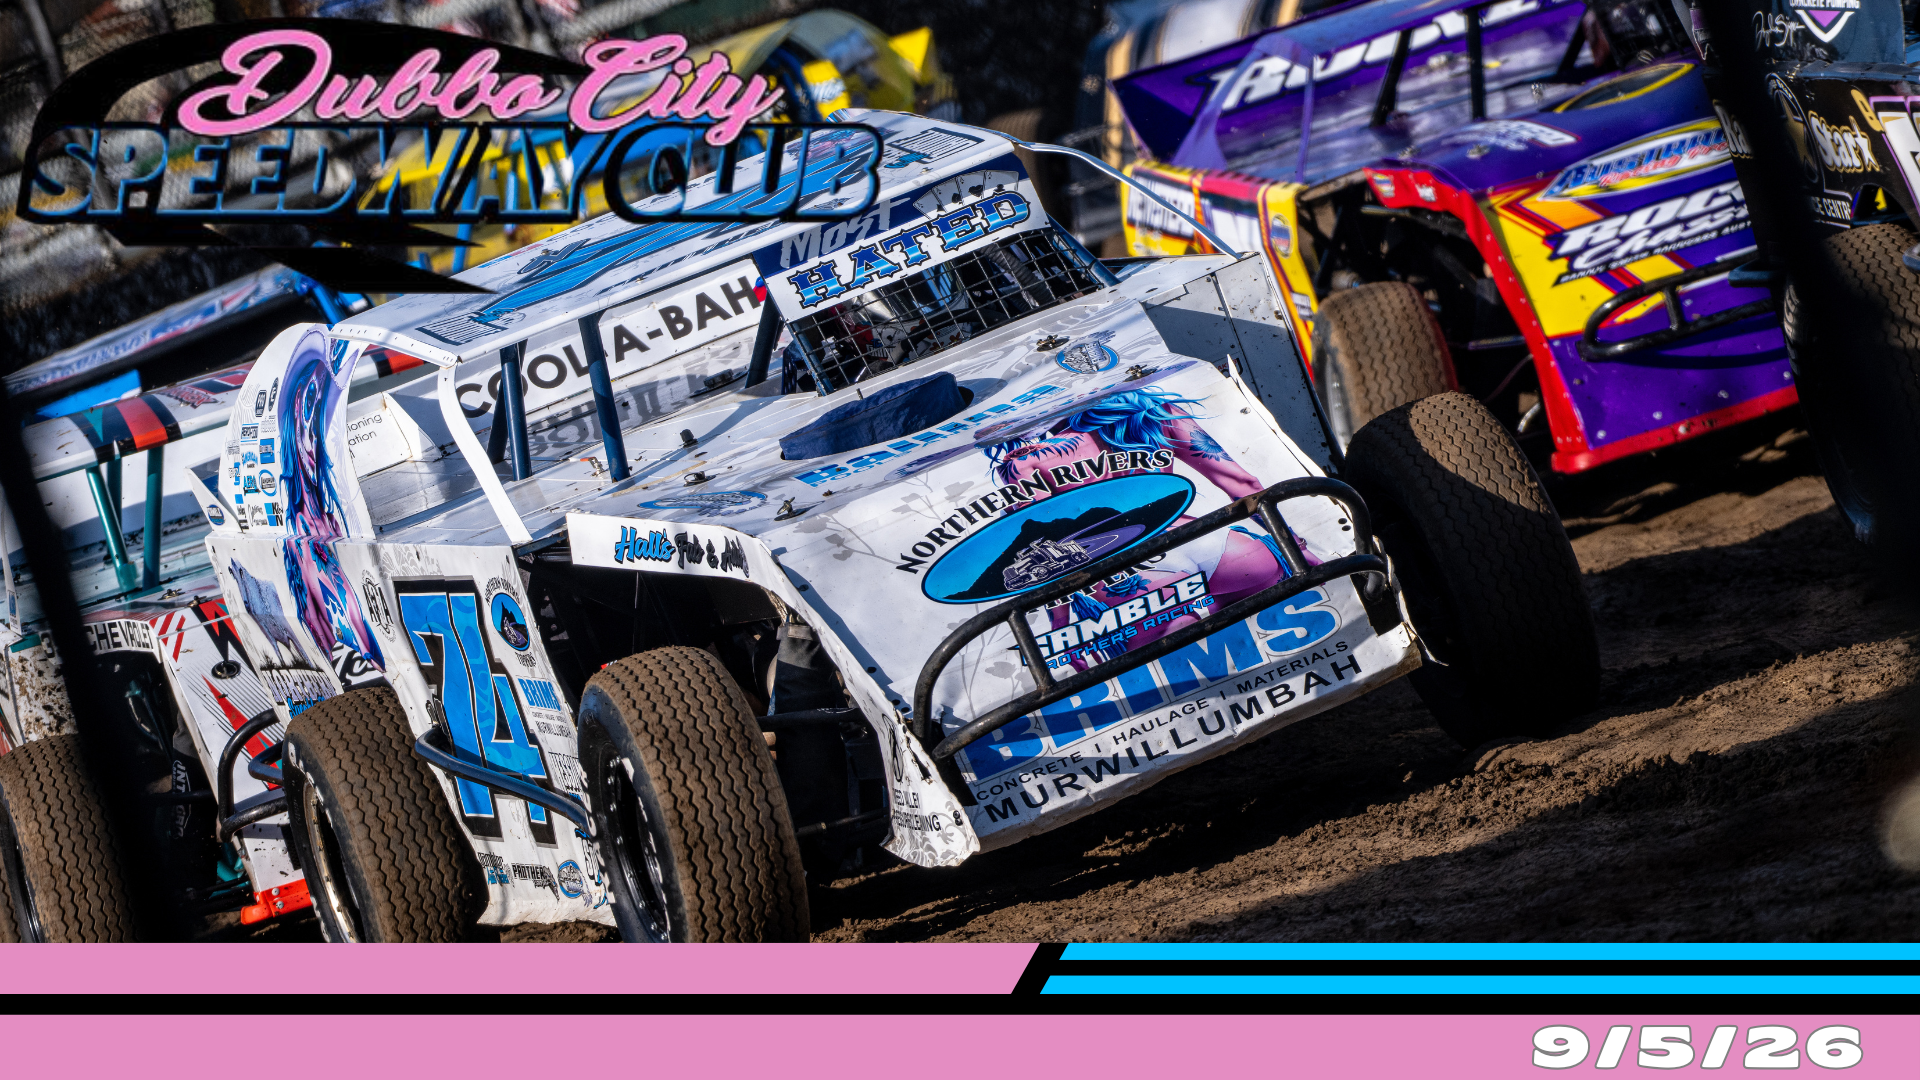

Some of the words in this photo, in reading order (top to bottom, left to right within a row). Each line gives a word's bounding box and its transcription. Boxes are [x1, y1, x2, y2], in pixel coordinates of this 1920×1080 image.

[779, 195, 911, 270] Most
[786, 190, 1031, 309] HATED
[614, 525, 676, 564] Hall's
[896, 469, 1051, 575] NORTHERN
[1050, 447, 1175, 489] RIVERS
[966, 585, 1341, 787] BRIMS
[1044, 625, 1138, 671] ROTHERS
[1143, 595, 1215, 631] RACING
[518, 677, 562, 712] BRIMS
[976, 750, 1084, 801] CONCRETE
[1112, 696, 1209, 746] HAULAGE
[1236, 638, 1350, 694] MATERIALS
[984, 653, 1364, 822] MURWILLUMBAH
